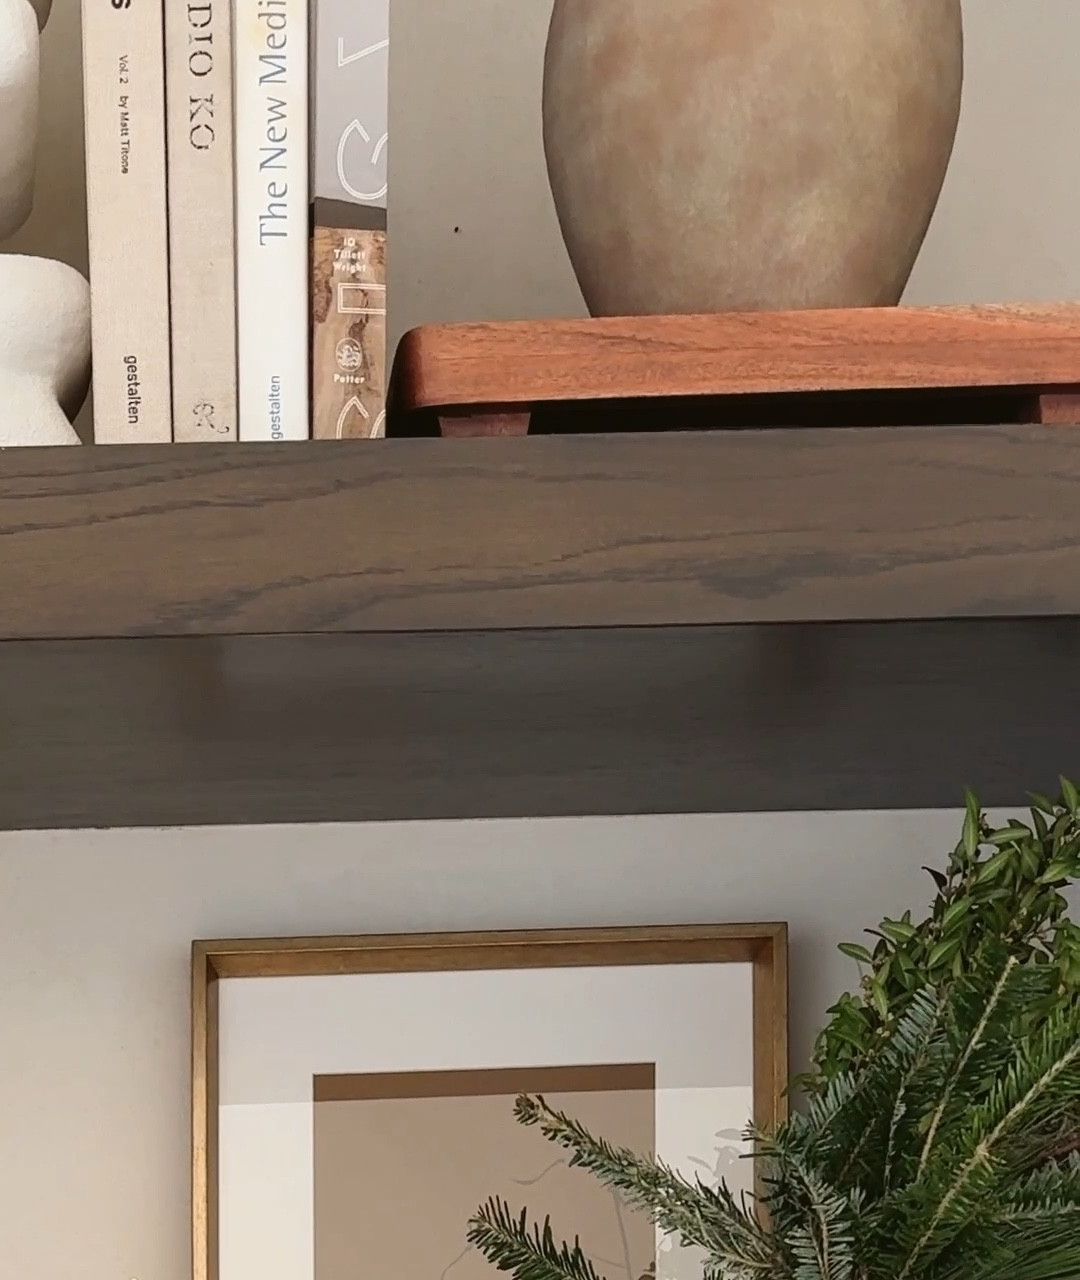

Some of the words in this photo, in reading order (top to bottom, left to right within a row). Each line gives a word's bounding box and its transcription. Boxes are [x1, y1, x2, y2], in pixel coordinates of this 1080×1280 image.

[118, 95, 128, 108] by
[120, 111, 130, 136] Matt
[189, 94, 215, 150] KO
[259, 97, 288, 172] New
[259, 181, 288, 246] The
[124, 355, 142, 425] gestalten
[267, 374, 284, 440] gestalten
[333, 373, 366, 385] Potter
